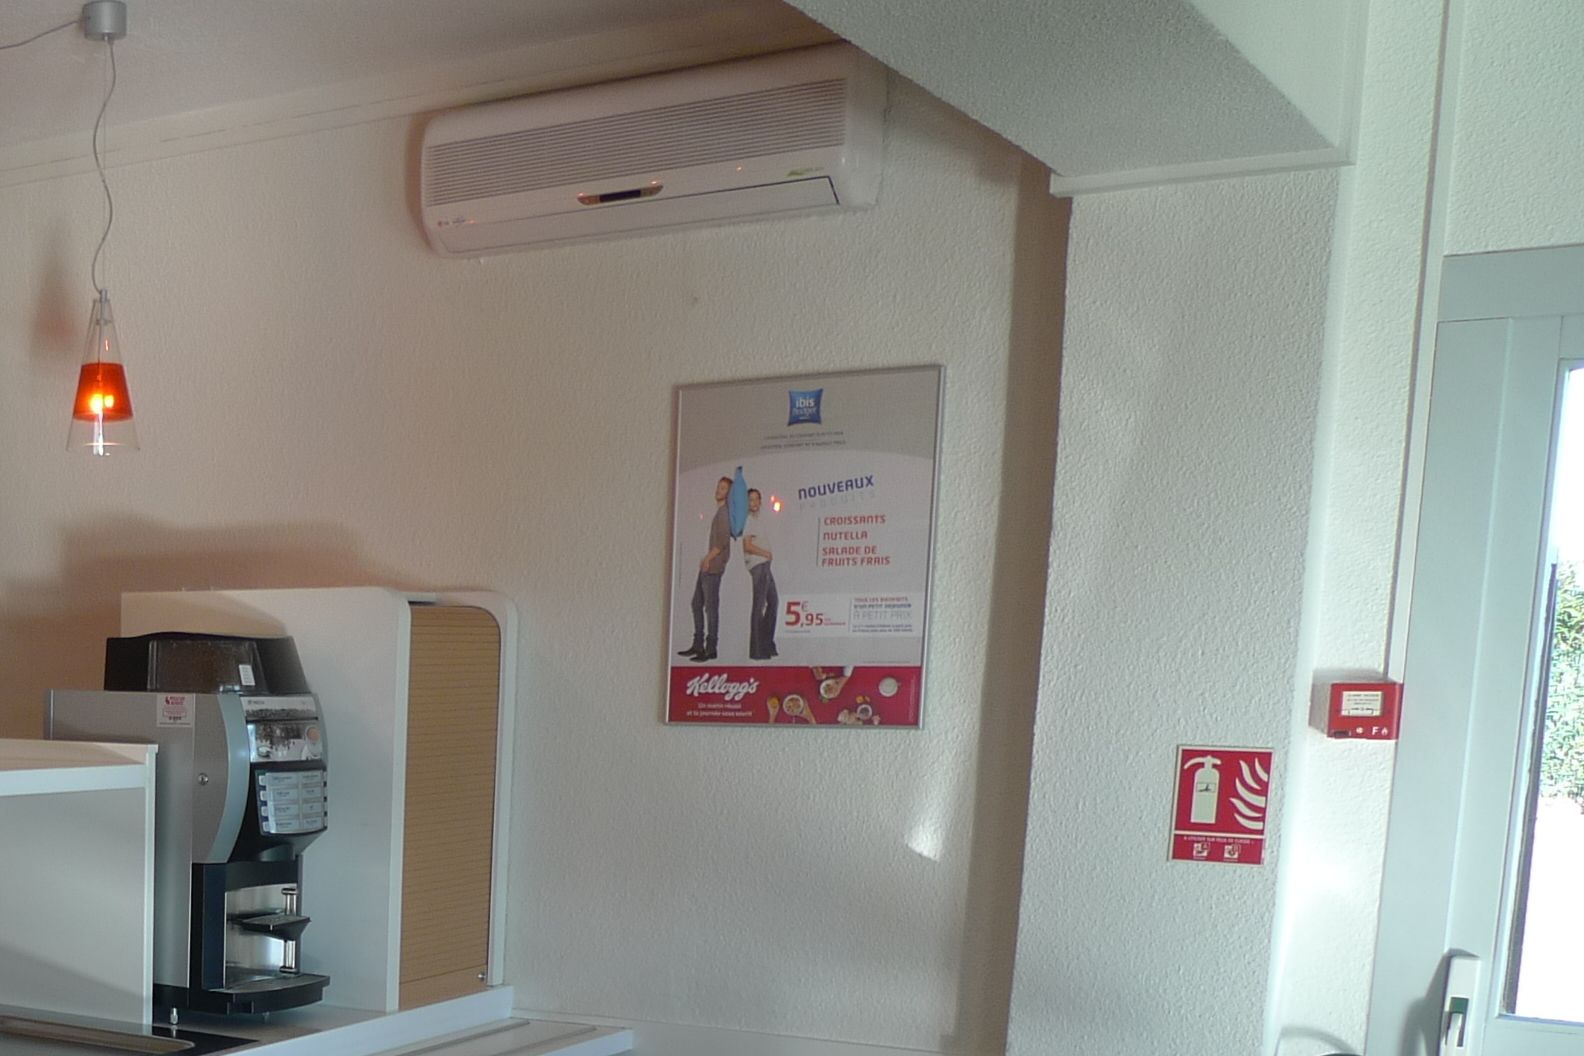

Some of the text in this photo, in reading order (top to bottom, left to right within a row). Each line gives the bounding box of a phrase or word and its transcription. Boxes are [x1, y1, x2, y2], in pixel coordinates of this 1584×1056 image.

[796, 396, 816, 408] ibis
[798, 475, 874, 500] NOUVEAUX
[823, 514, 886, 526] CROISSANTS
[823, 530, 868, 541] NUTELLA
[822, 545, 877, 556] SALADE DE
[821, 556, 891, 567] FRUITS FRAIS
[686, 673, 760, 701] Kellogg's
